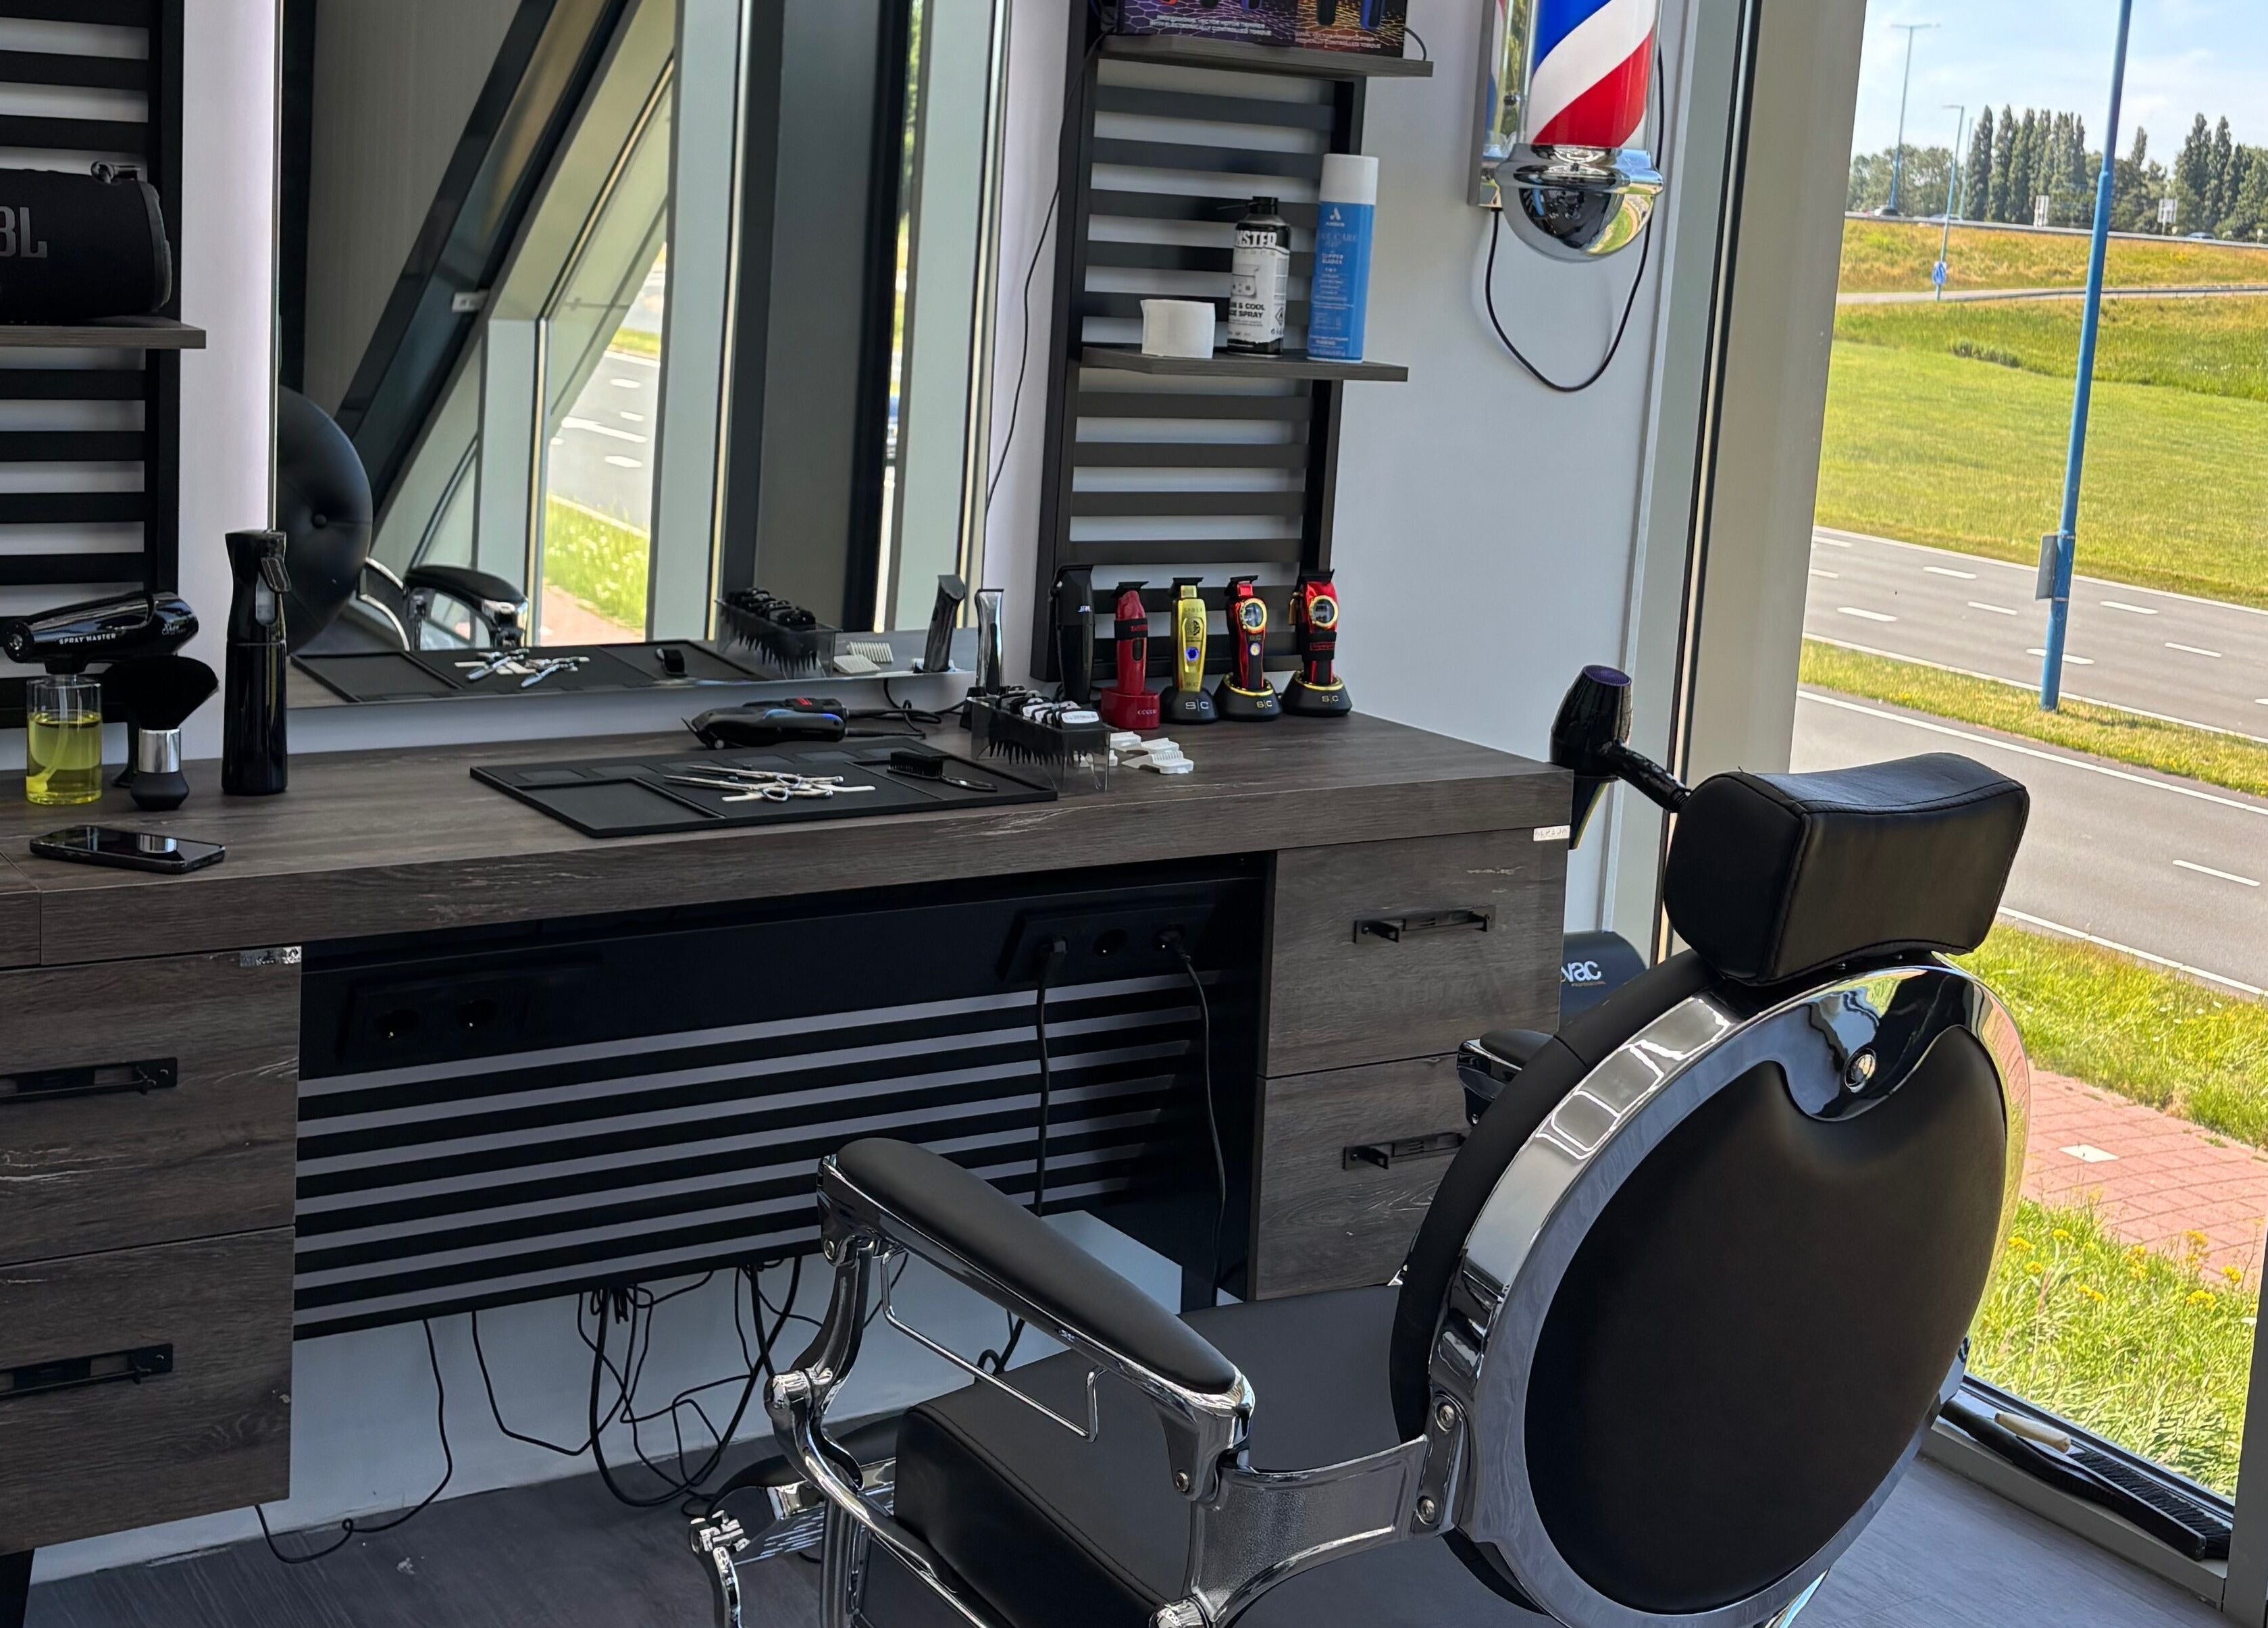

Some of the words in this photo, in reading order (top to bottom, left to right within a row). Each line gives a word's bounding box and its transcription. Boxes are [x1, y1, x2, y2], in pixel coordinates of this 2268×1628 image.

[1245, 303, 1265, 311] COOL
[1239, 310, 1264, 319] SPRAY
[59, 636, 84, 645] SPRAY
[86, 632, 116, 642] MASTER
[1561, 961, 1601, 983] vac
